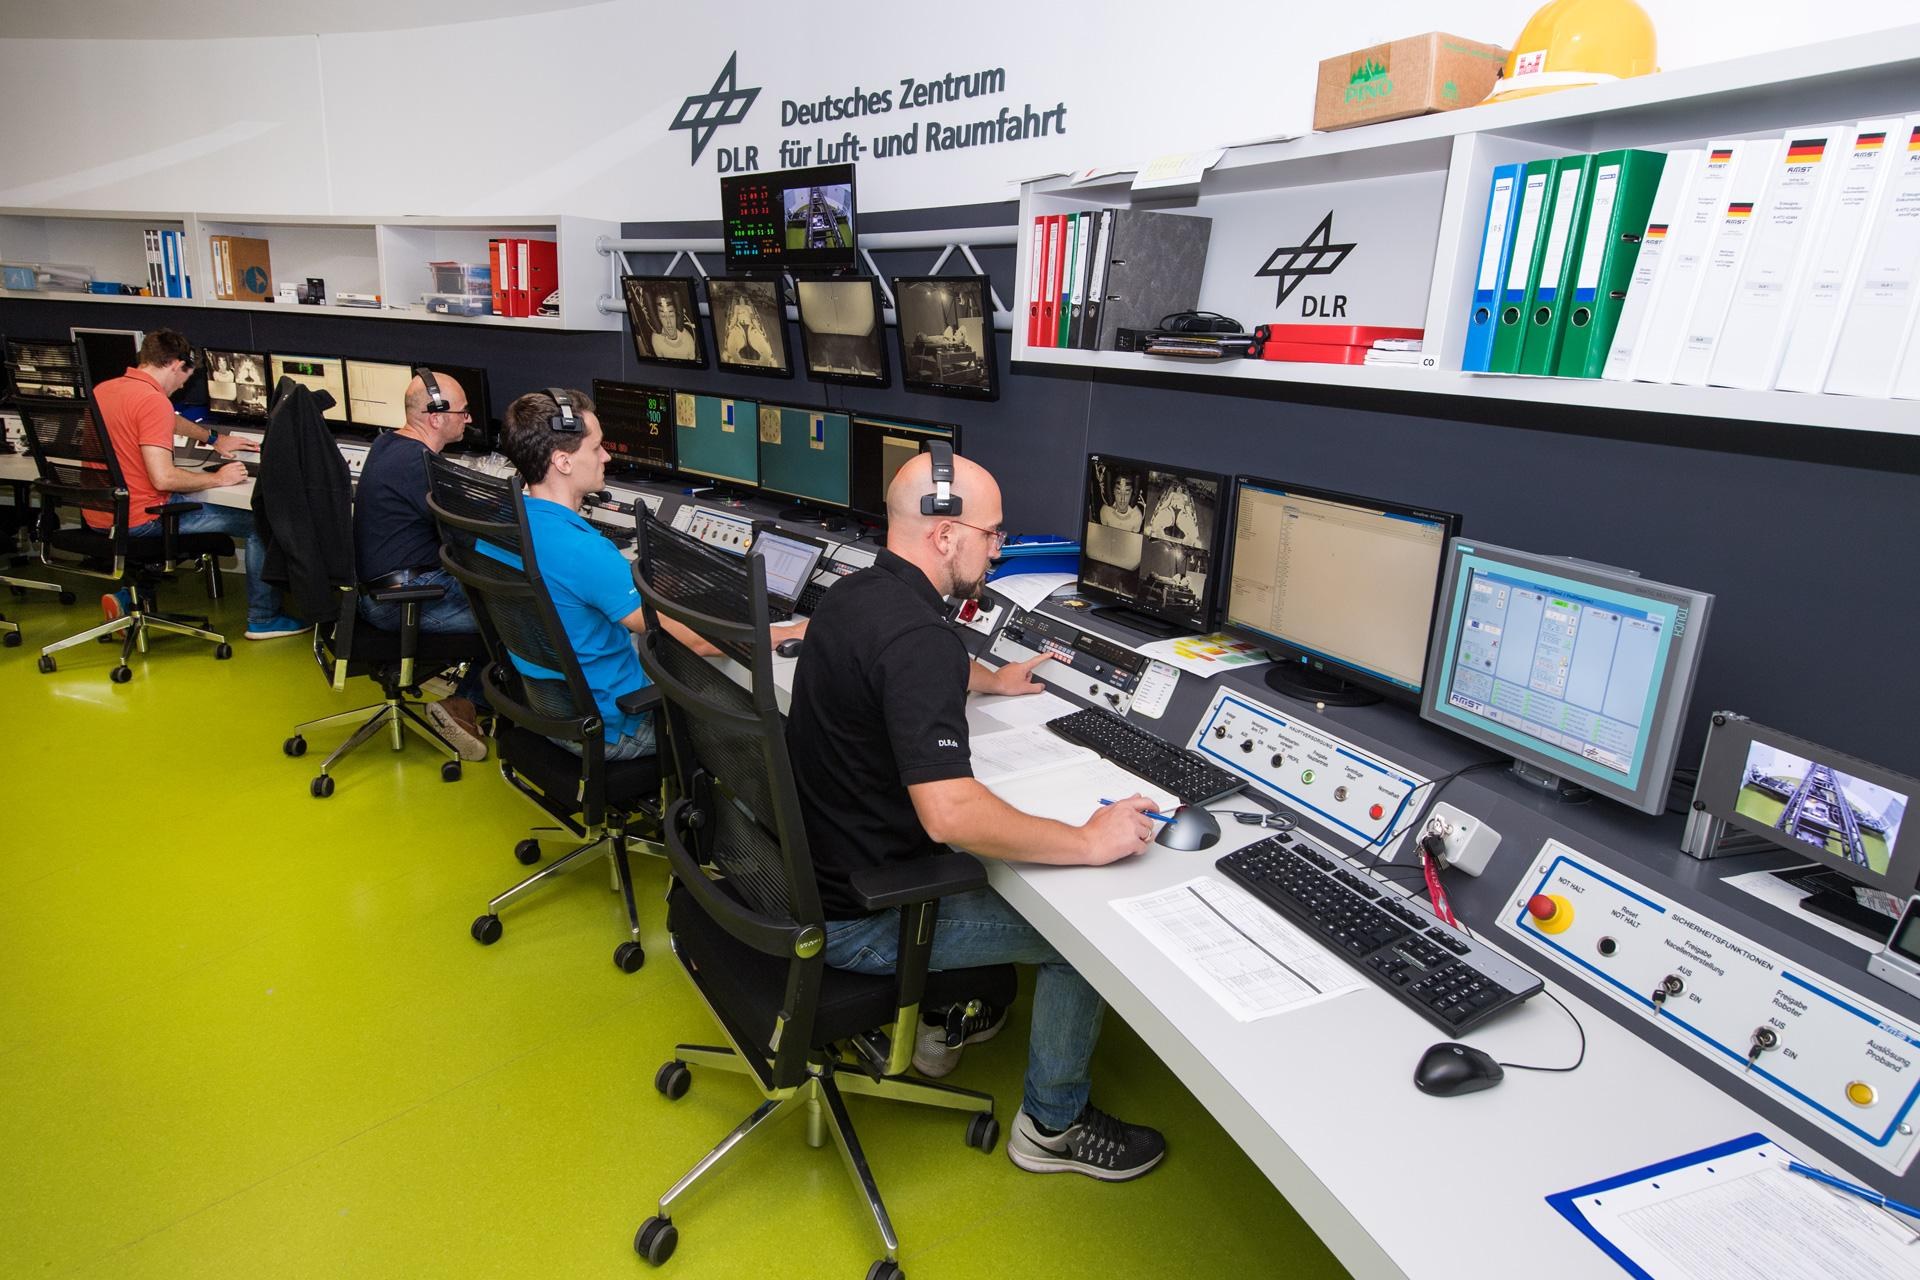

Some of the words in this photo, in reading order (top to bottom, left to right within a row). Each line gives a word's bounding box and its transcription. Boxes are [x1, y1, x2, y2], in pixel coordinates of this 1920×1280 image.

[781, 86, 892, 127] Deutsches
[899, 67, 1006, 110] Zentrum
[1344, 79, 1393, 104] PINO
[779, 140, 811, 169] für
[817, 132, 867, 165] Luft-
[873, 123, 918, 158] und
[925, 102, 1067, 152] Raumfahrt
[717, 146, 759, 173] DLR
[1301, 294, 1347, 318] DLR
[1423, 358, 1435, 367] CO
[648, 398, 657, 410] 89
[649, 423, 659, 436] 25
[1673, 607, 1689, 638] TOUCH
[1451, 694, 1482, 710] AMST
[1289, 726, 1334, 749] HAUPTVERSORGUNG
[1558, 876, 1570, 888] NOT
[1570, 882, 1585, 894] HALT
[1611, 909, 1625, 921] NOT
[1625, 916, 1641, 929] HALT
[1621, 905, 1639, 918] Reset
[1671, 913, 1774, 971] SICHERHEITSFUNKTIONEN
[1684, 939, 1712, 959] Freigabe
[1664, 938, 1725, 976] Nacellenverstellung
[1677, 965, 1692, 977] AUS
[1689, 993, 1702, 1004] EIN
[1771, 998, 1802, 1018] Roboter
[1775, 990, 1808, 1012] Freigabe
[1768, 1017, 1786, 1030] AUS
[1783, 1047, 1798, 1060] EIN
[1866, 1039, 1911, 1068] Auslösung
[1866, 1049, 1902, 1072] Proband
